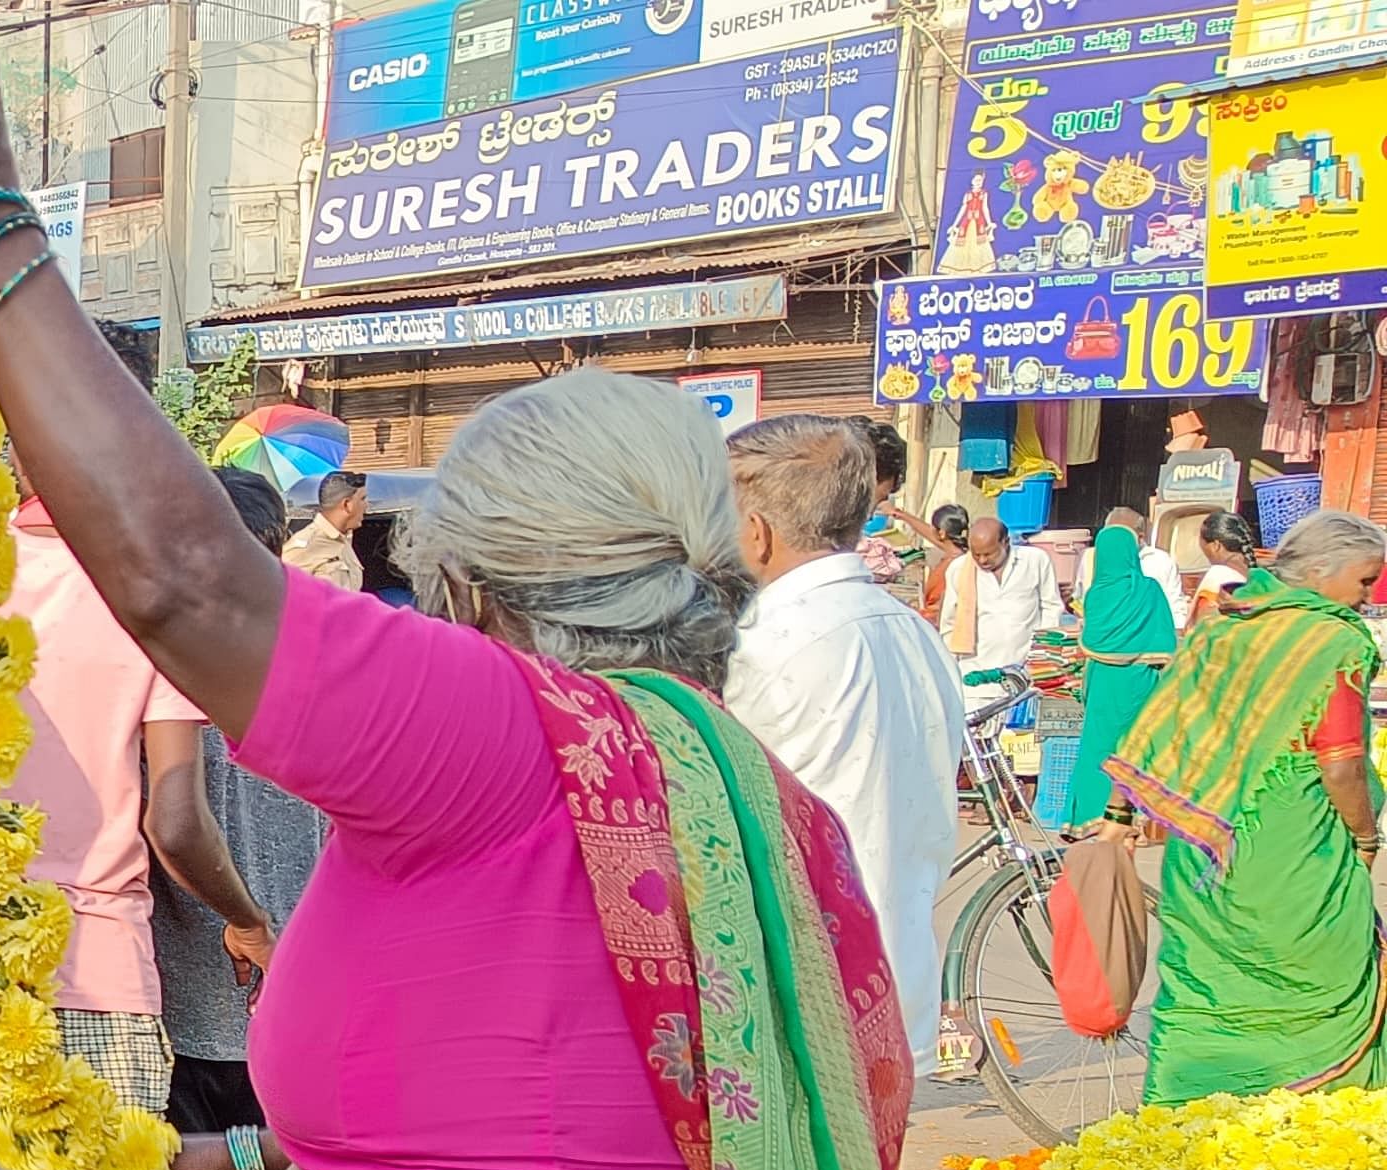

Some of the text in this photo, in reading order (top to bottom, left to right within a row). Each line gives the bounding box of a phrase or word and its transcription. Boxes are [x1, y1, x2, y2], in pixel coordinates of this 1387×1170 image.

[535, 26, 560, 41] Boost
[581, 12, 622, 30] Curiosity
[709, 0, 885, 38] SURESH TRADER
[745, 62, 770, 80] GST
[1243, 54, 1296, 71] Address
[1307, 40, 1355, 58] Gandhi
[348, 52, 427, 92] CASIO
[745, 87, 761, 102] Ph
[967, 98, 1029, 160] 5
[1141, 82, 1210, 144] 9
[314, 104, 891, 245] SURESH TRADERS
[715, 173, 884, 226] BOOKS STALL
[47, 220, 73, 237] AGS
[584, 216, 619, 233] Computer
[658, 203, 689, 220] General
[1226, 225, 1307, 241] Water Management
[1223, 228, 1360, 250] Plumbing Drainage Sewerage
[454, 310, 510, 338] SHOOL
[514, 312, 523, 331] &
[526, 301, 592, 333] COLLEGE
[1117, 294, 1254, 391] 169
